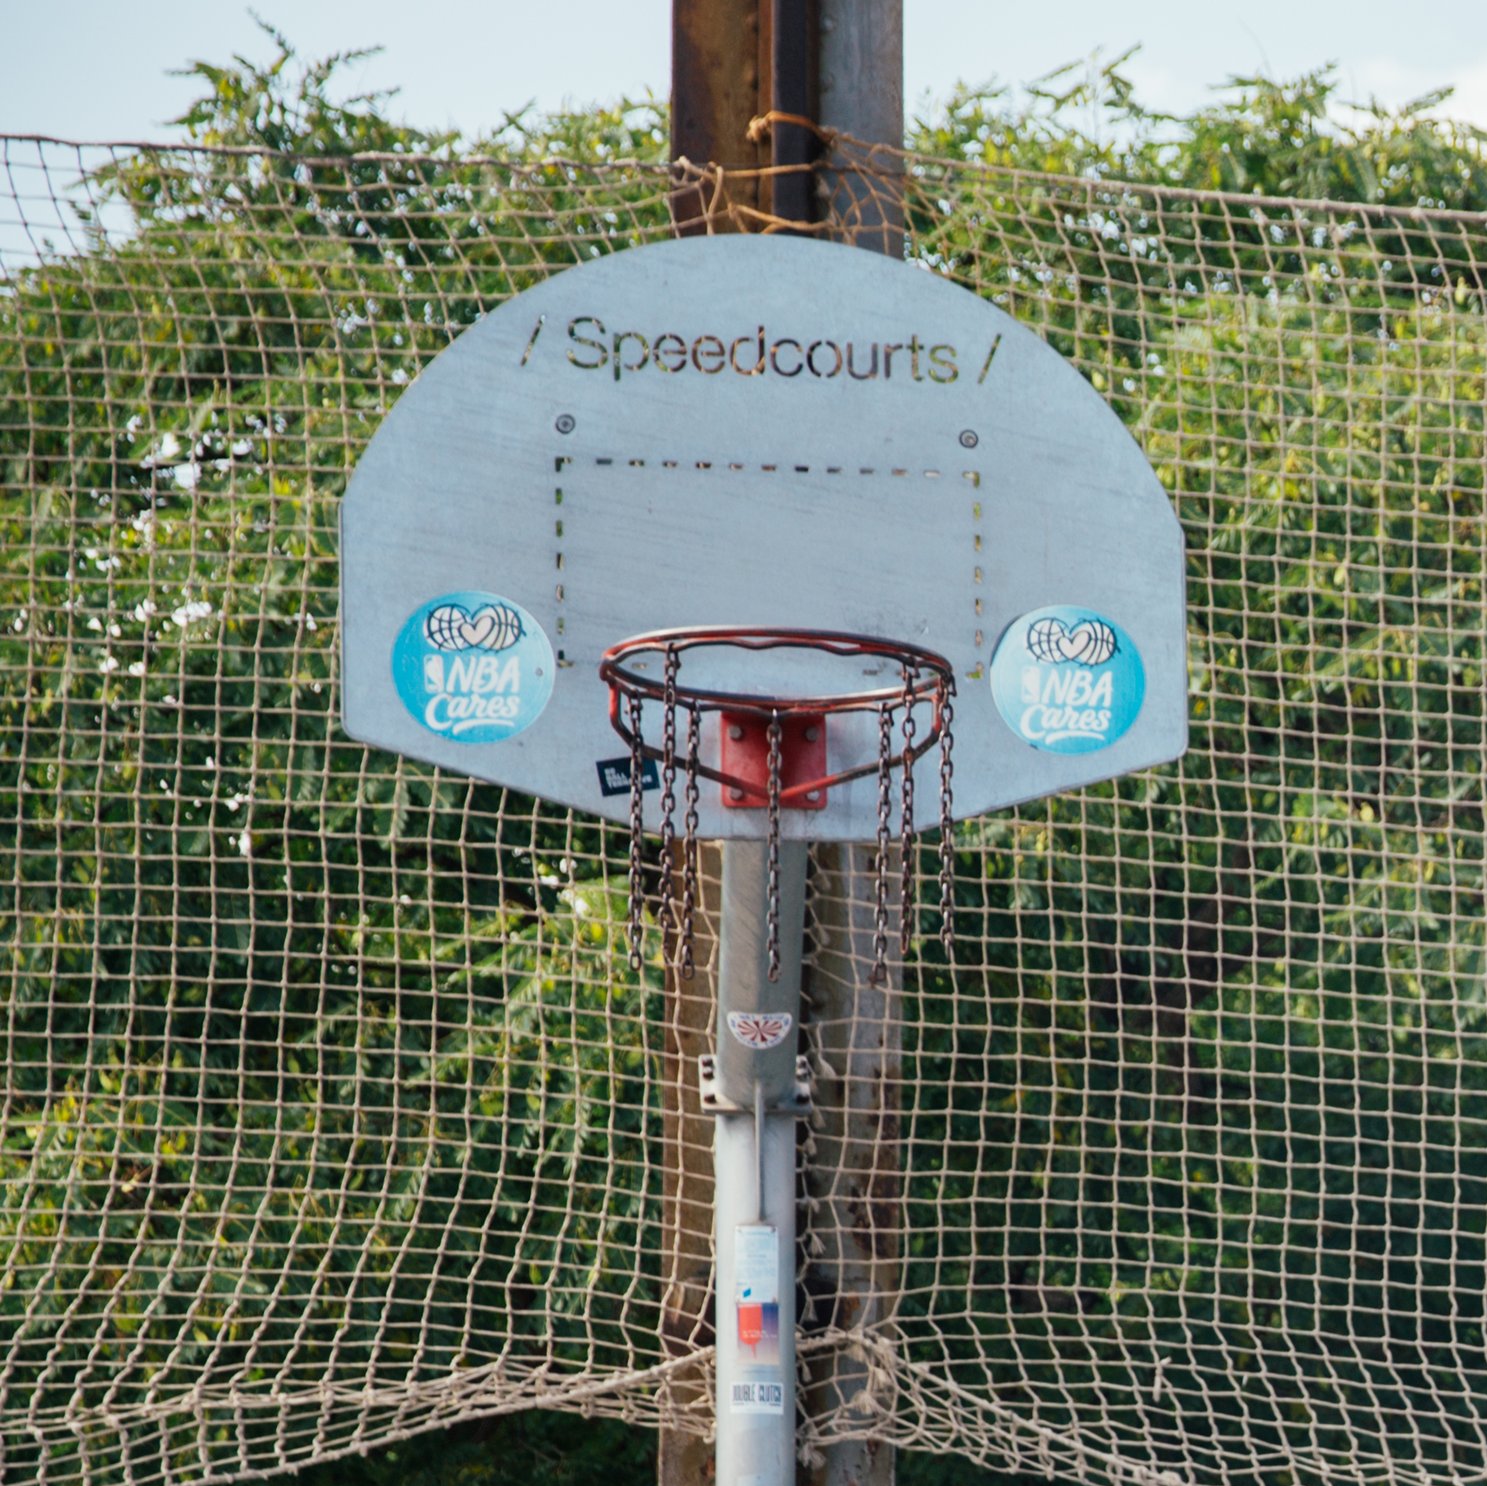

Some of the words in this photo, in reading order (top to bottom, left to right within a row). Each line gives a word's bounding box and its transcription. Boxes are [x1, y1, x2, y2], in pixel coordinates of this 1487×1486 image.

[567, 317, 958, 383] Speedcourts
[447, 656, 520, 693] NBA
[1043, 669, 1112, 707] NBA
[425, 693, 521, 731] Cares
[1020, 704, 1111, 739] Cares
